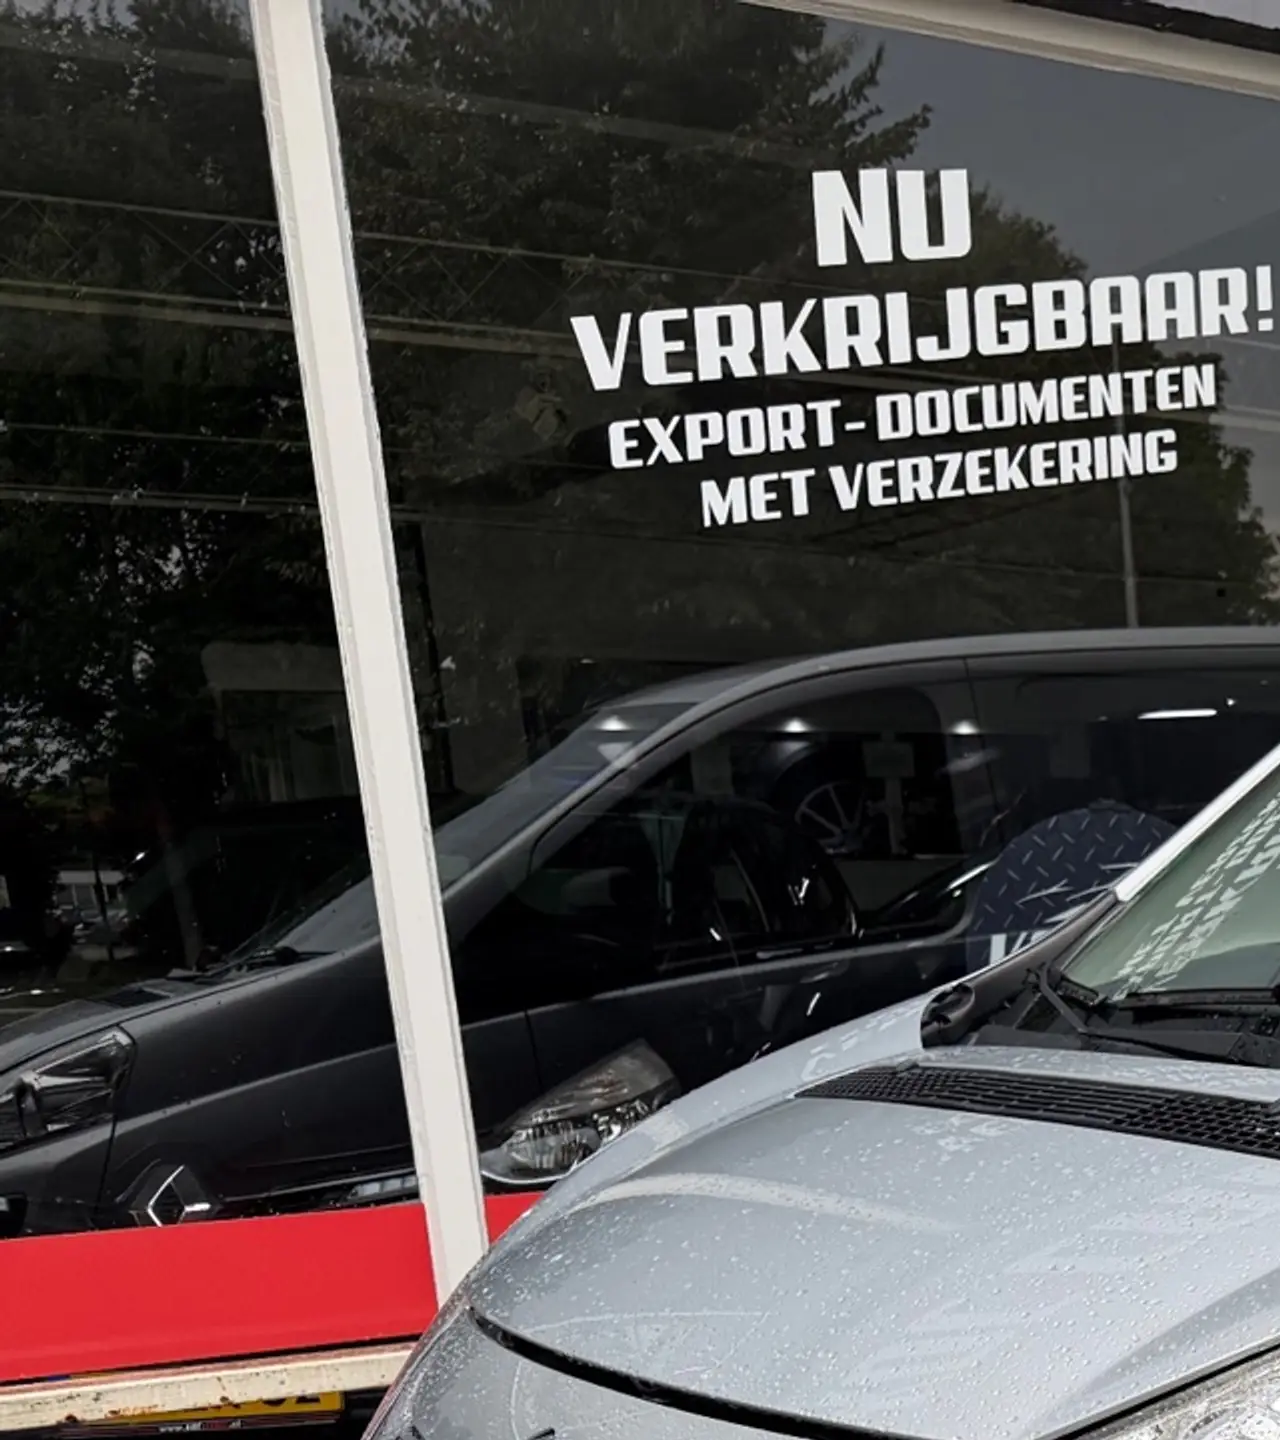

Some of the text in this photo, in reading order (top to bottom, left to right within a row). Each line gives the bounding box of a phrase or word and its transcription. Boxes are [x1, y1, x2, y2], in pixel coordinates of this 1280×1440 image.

[812, 168, 972, 266] NU
[570, 265, 1274, 390] VERKRIJGBAAR!
[700, 429, 1177, 527] MET VERZEKERING
